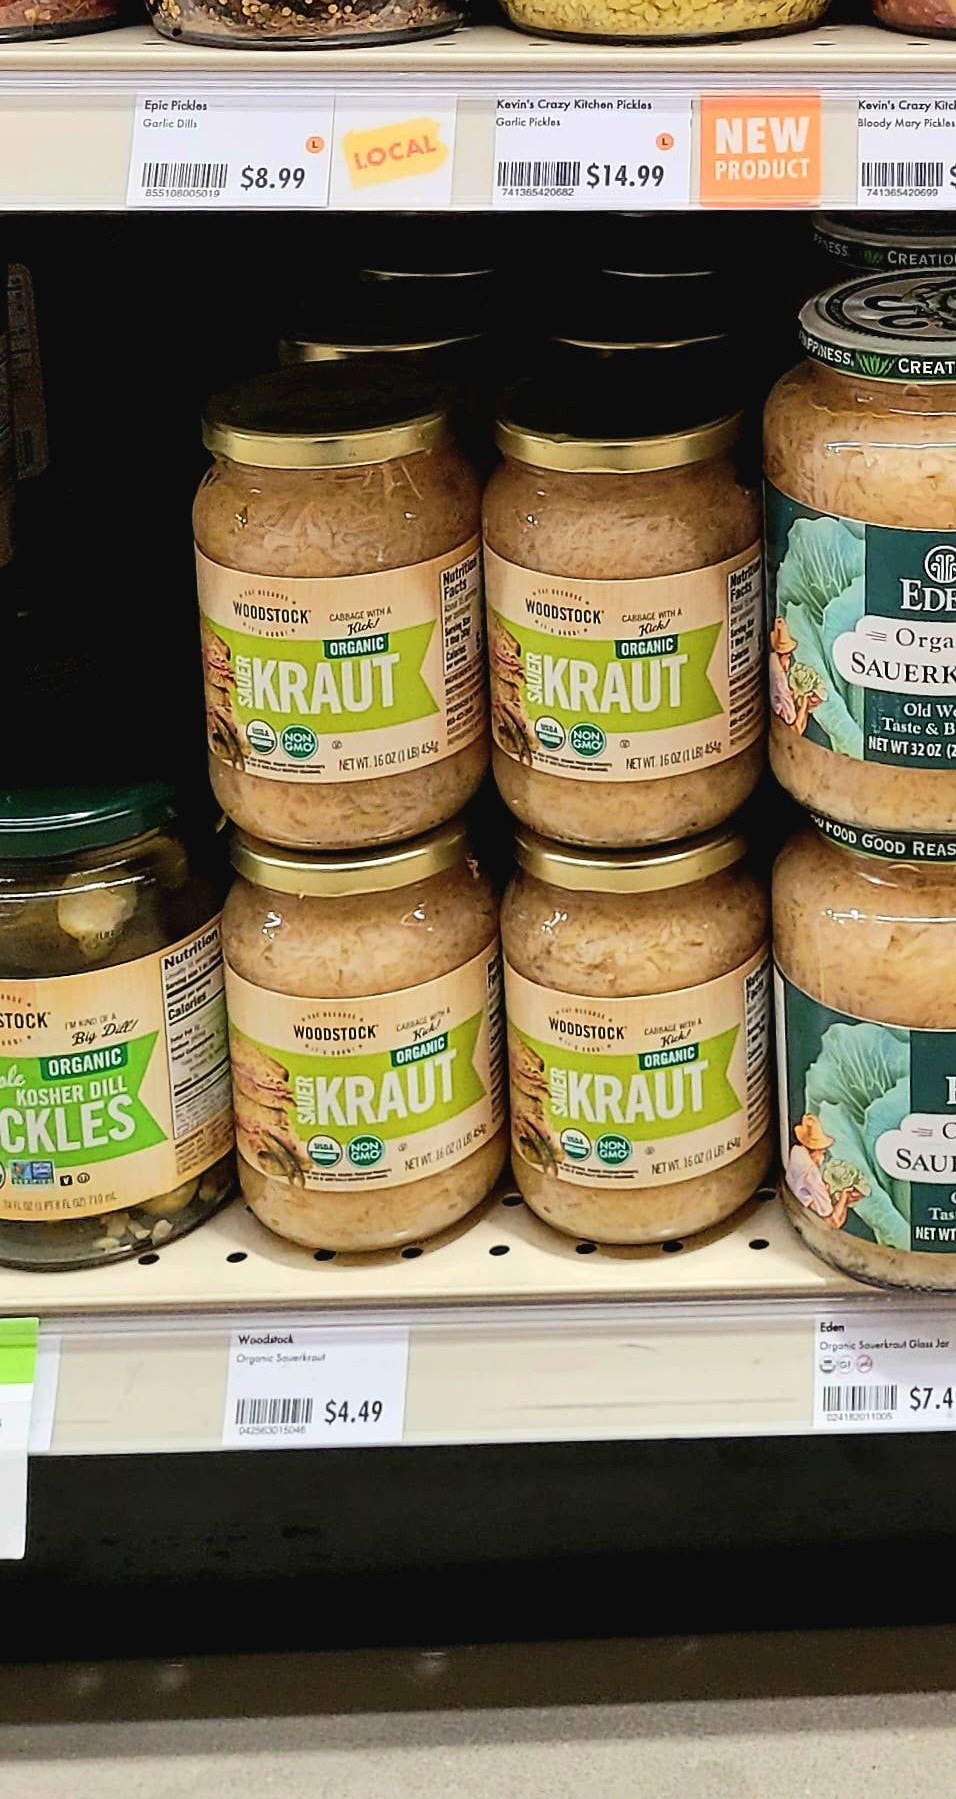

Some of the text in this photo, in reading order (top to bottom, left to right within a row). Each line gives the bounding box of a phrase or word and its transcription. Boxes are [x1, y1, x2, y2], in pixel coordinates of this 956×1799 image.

[144, 100, 208, 112] Epic Pickles
[497, 99, 652, 111] Kevin's Crazy Kitchen Pickles
[143, 119, 197, 128] Garlic Dills
[496, 117, 560, 127] Garlic Pickles
[858, 118, 955, 129] Bloody Mary Pickles
[715, 117, 809, 153] NEW
[354, 135, 437, 170] LOCAL
[240, 165, 305, 190] $8.99
[587, 163, 664, 188] $14.99
[715, 159, 809, 180] PRODUCT
[232, 601, 309, 624] WOODSTOCK
[330, 637, 384, 655] ORGANIC
[622, 639, 674, 656] ORGANIC
[252, 655, 400, 714] KRAUT
[544, 655, 688, 713] KRAUT
[904, 703, 931, 717] Old
[881, 717, 924, 733] Taste
[928, 722, 939, 734] &
[294, 1025, 376, 1041] WOODSTOCK
[549, 1017, 624, 1039] WOODSTOCK
[396, 1037, 444, 1063] ORGANIC
[644, 1049, 694, 1067] ORGANIC
[48, 1048, 122, 1076] ORGANIC
[17, 1076, 128, 1107] KOSHER DILL
[316, 1049, 456, 1127] KRAUT
[568, 1061, 708, 1123] KRAUT
[820, 1322, 844, 1332] Eden
[820, 1339, 949, 1350] Organic Sauerkraut Glass Jar
[325, 1399, 383, 1424] $4.49
